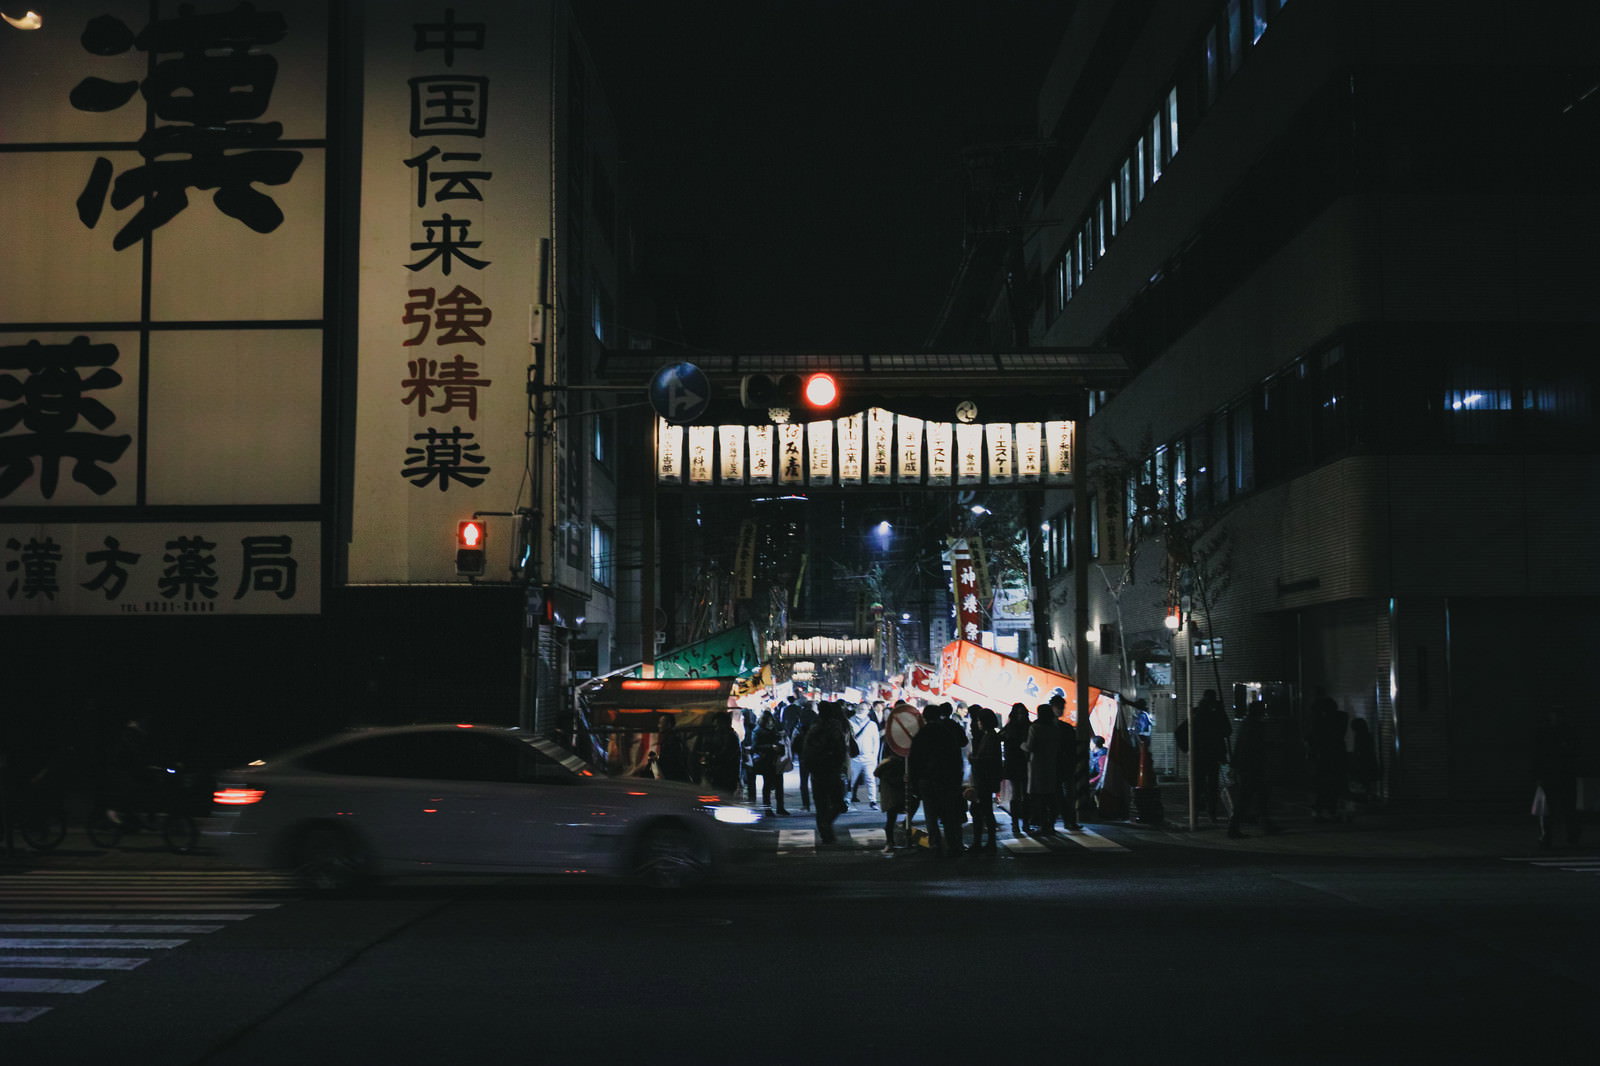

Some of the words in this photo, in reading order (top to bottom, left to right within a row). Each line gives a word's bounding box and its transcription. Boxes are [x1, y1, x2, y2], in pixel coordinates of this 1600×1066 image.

[402, 8, 493, 492] 中国伝来強精薬
[6, 535, 298, 600] 漢方薬局
[120, 603, 138, 612] TEL
